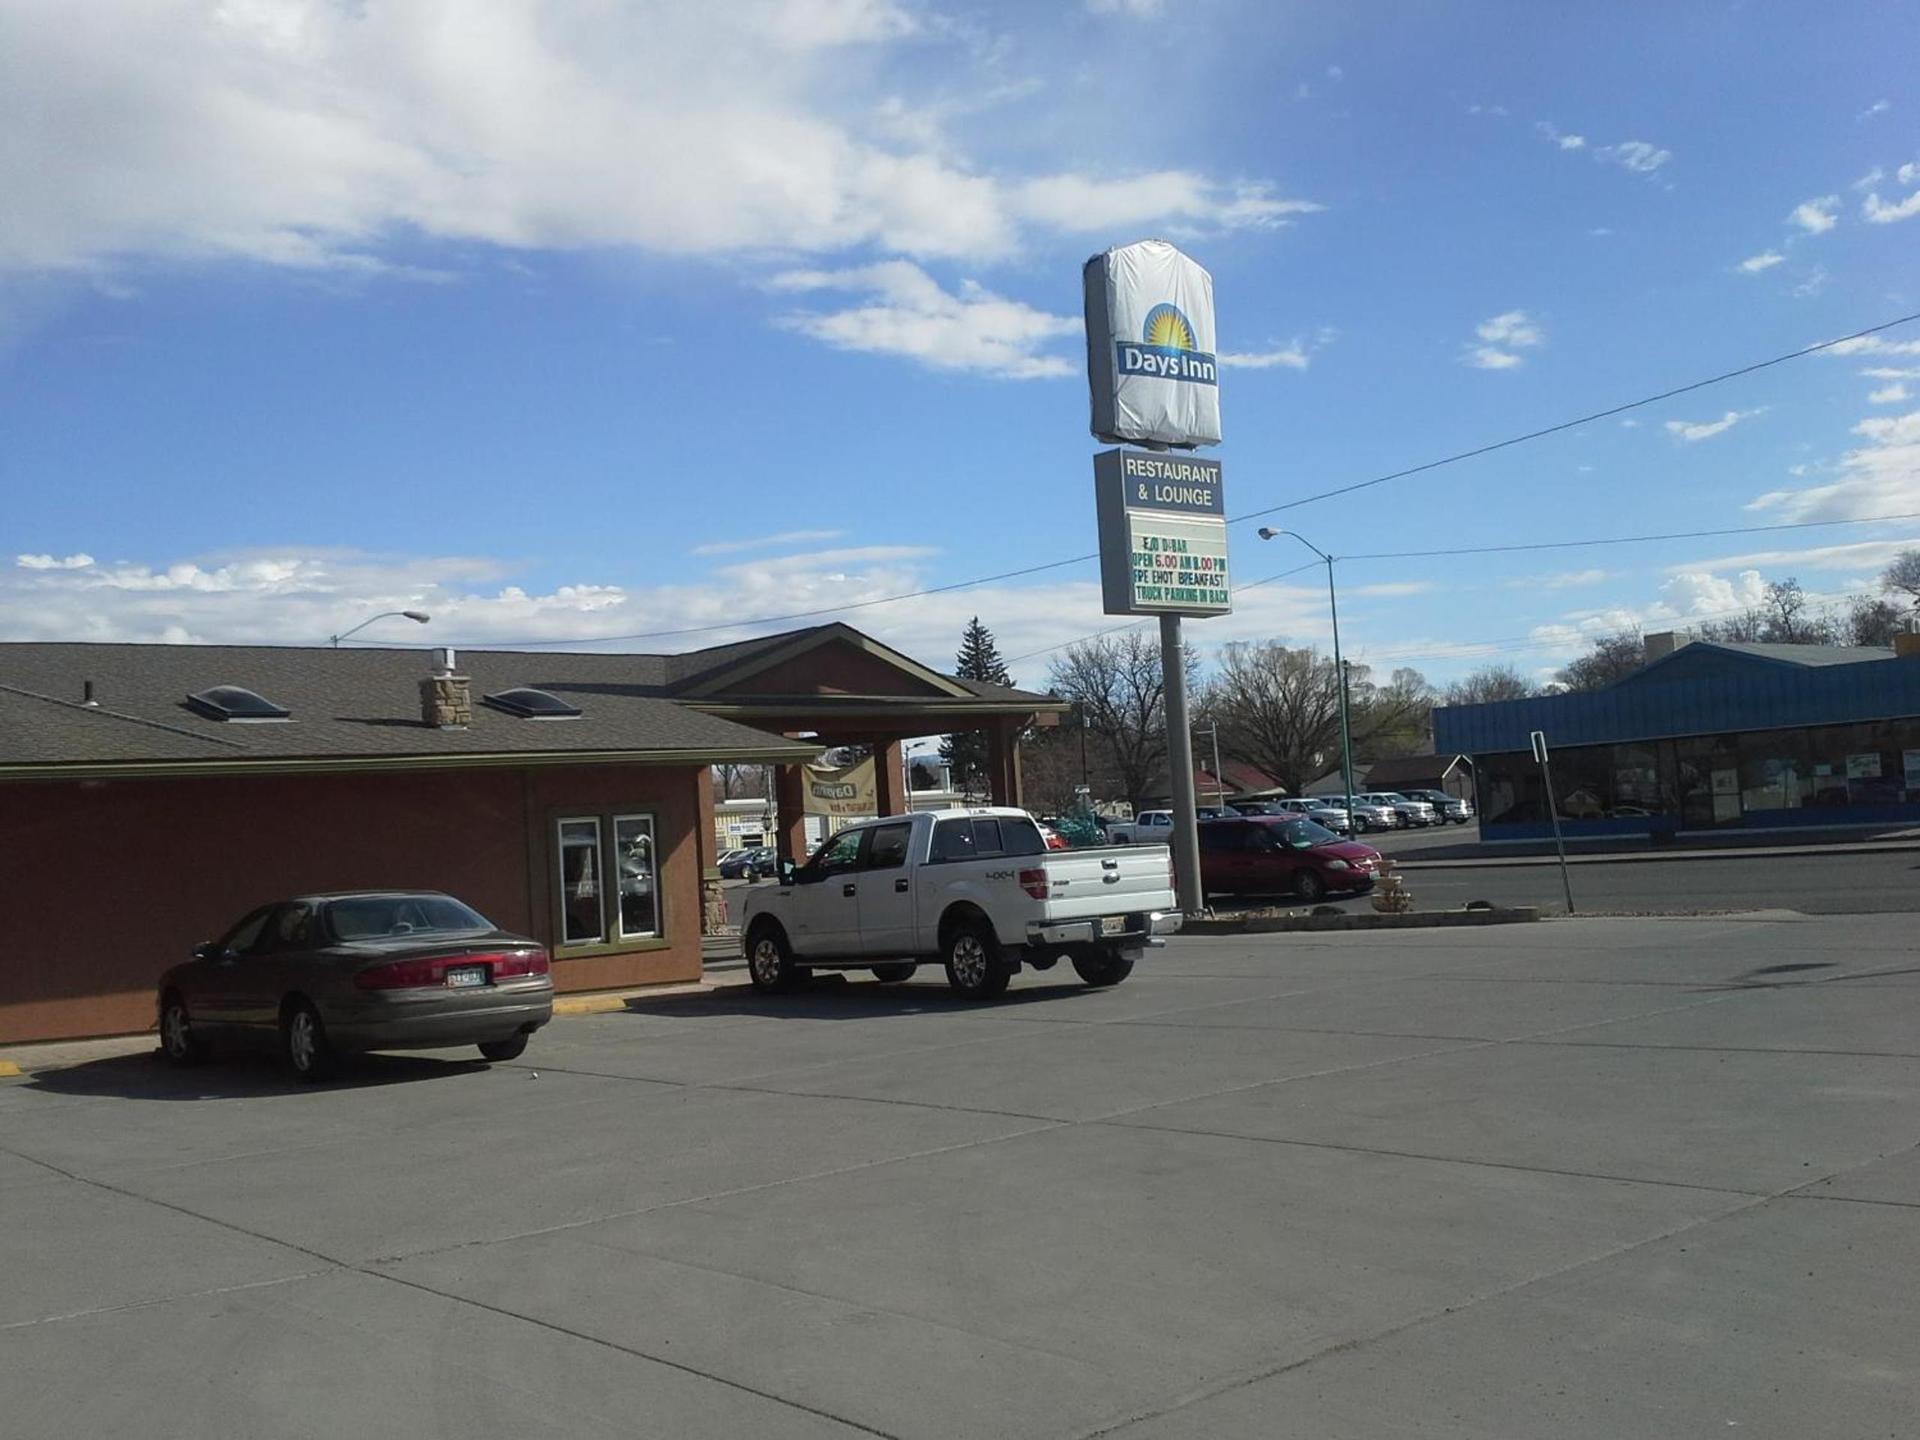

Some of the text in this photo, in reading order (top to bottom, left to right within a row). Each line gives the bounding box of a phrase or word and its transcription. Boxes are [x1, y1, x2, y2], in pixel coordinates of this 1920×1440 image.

[1126, 458, 1218, 484] RESTAURANT
[1138, 483, 1213, 506] & LOUNGE
[1132, 552, 1153, 567] OPEN
